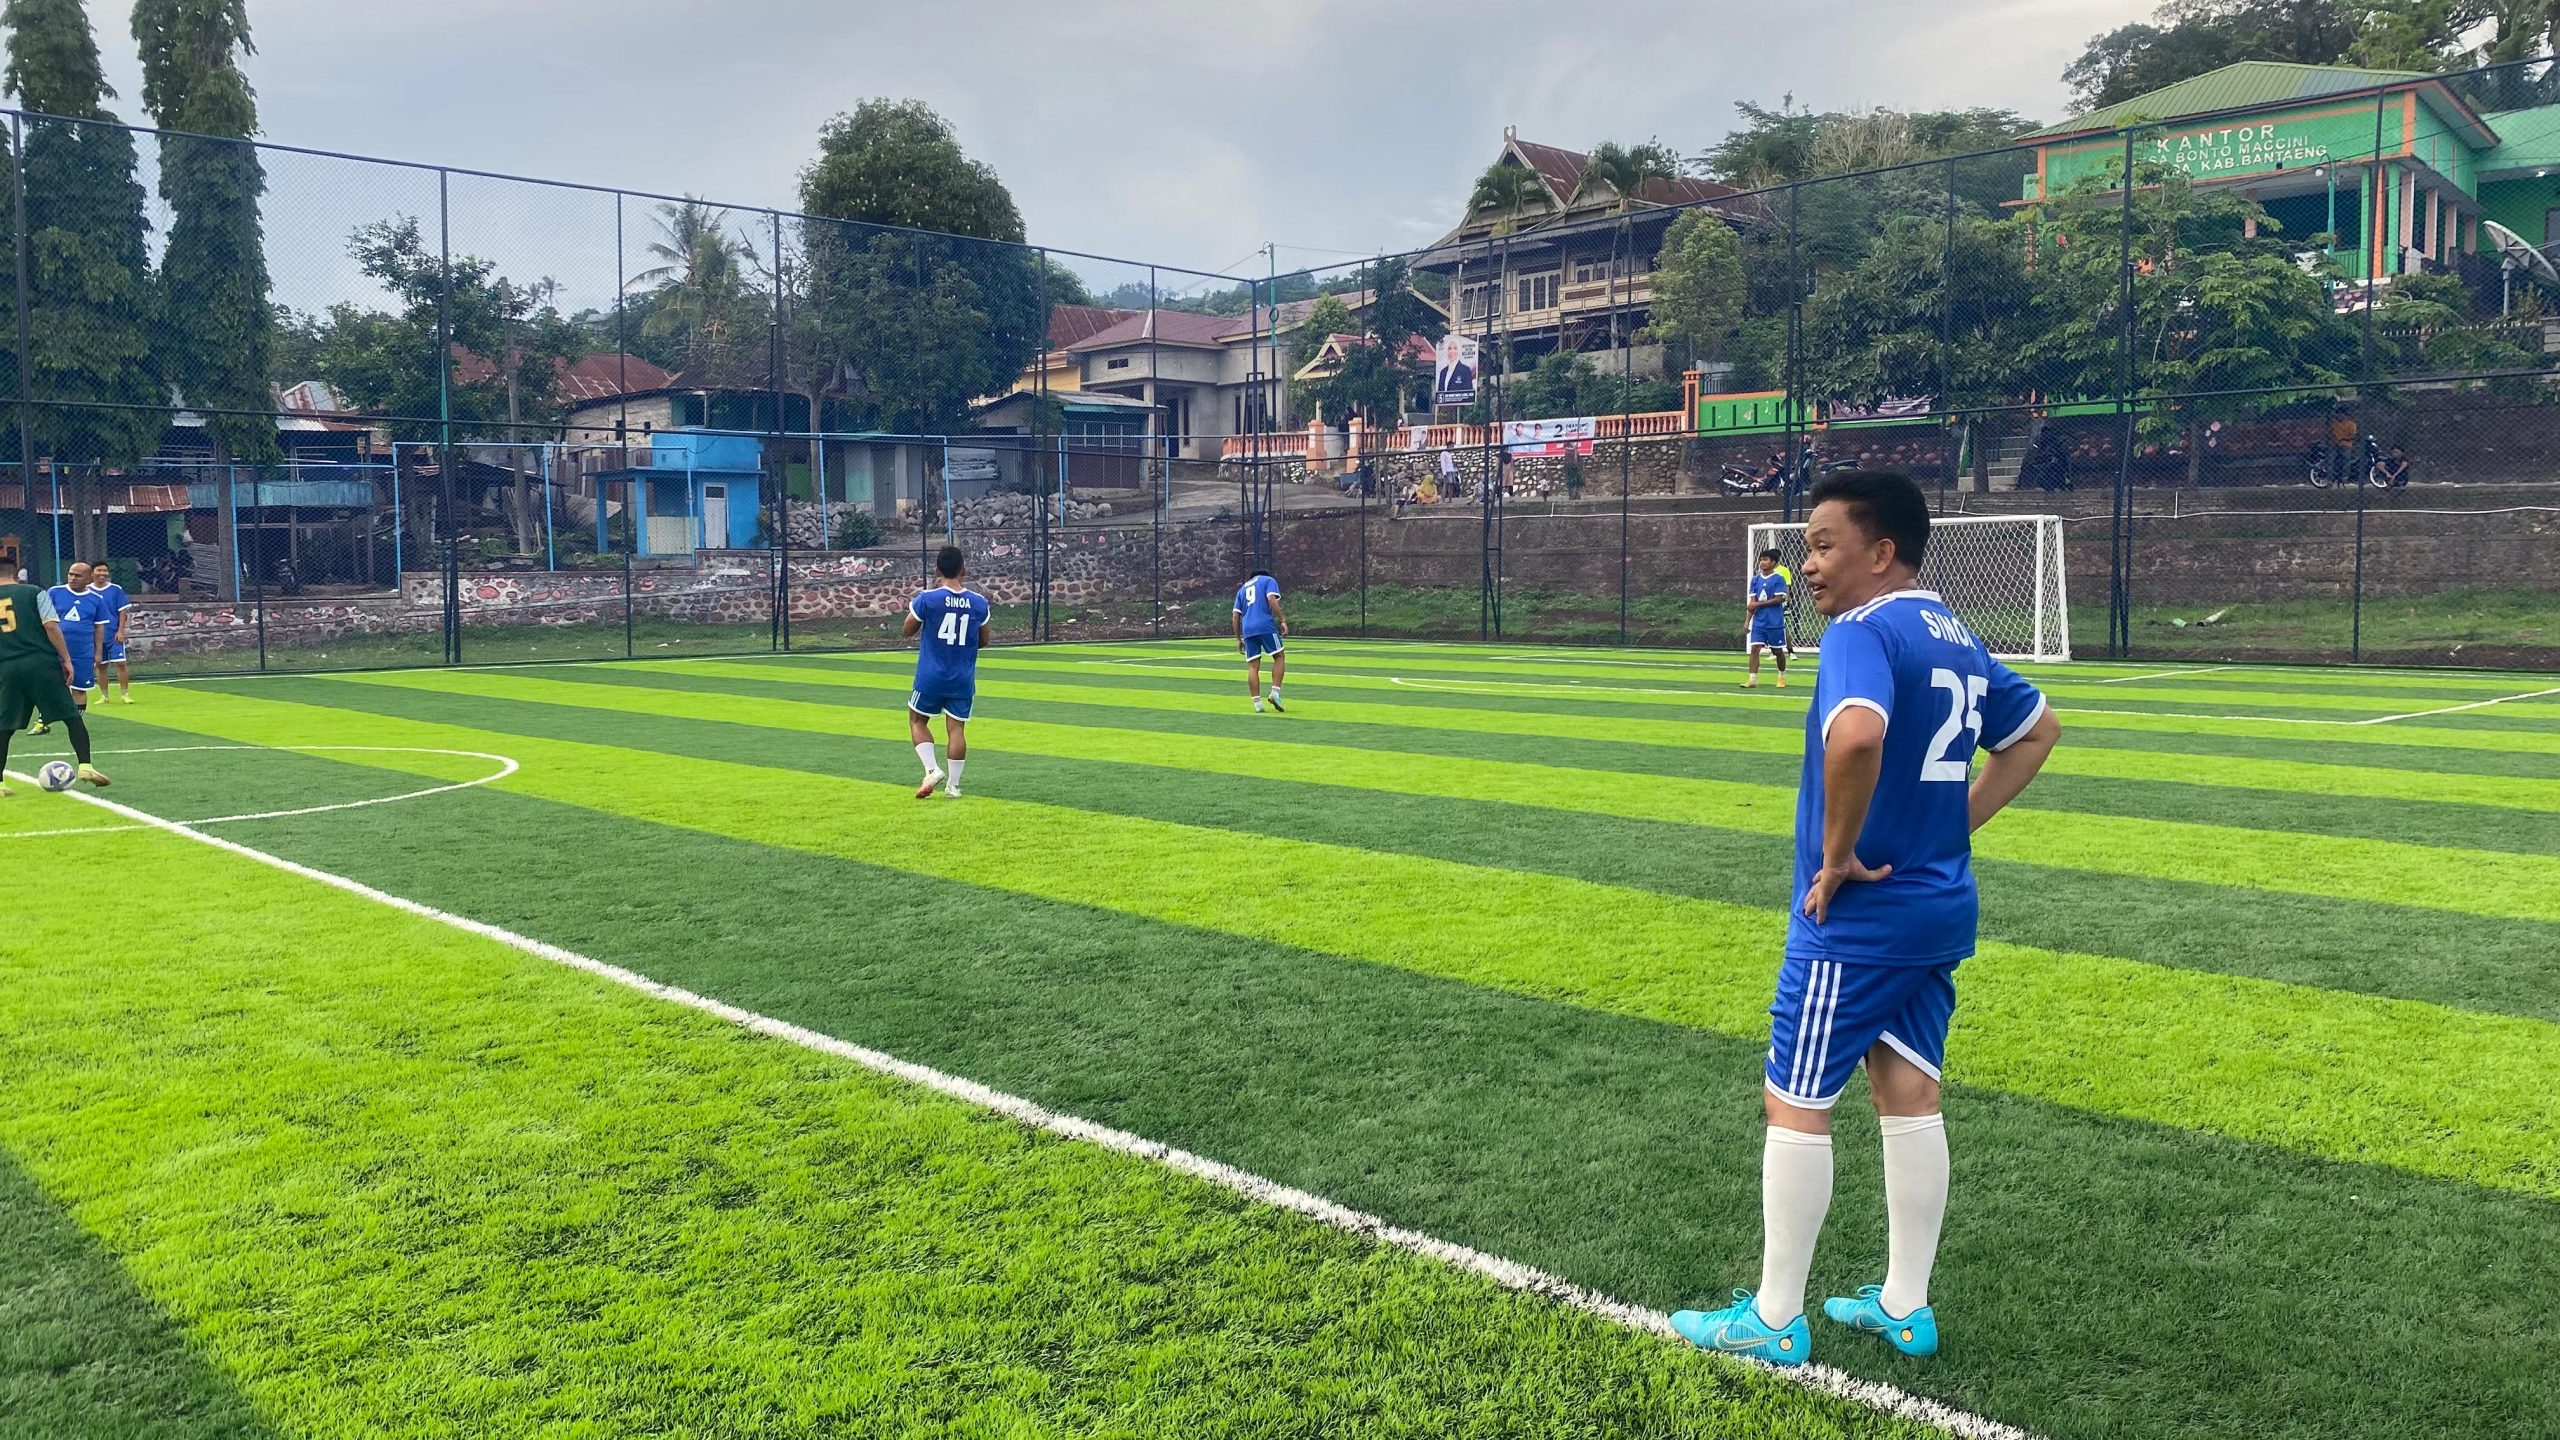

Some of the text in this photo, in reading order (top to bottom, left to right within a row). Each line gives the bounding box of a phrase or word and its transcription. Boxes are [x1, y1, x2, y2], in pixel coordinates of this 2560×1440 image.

[2157, 124, 2274, 153] KANTOR
[2176, 145, 2231, 163] BONTO
[2239, 135, 2309, 155] MACCINI
[2201, 145, 2327, 171] KAB.BANTAENG
[1554, 423, 1563, 438] 2
[945, 596, 971, 609] SINOA
[1245, 585, 1256, 607] 9
[937, 612, 970, 646] 41
[1919, 668, 1990, 782] 25
